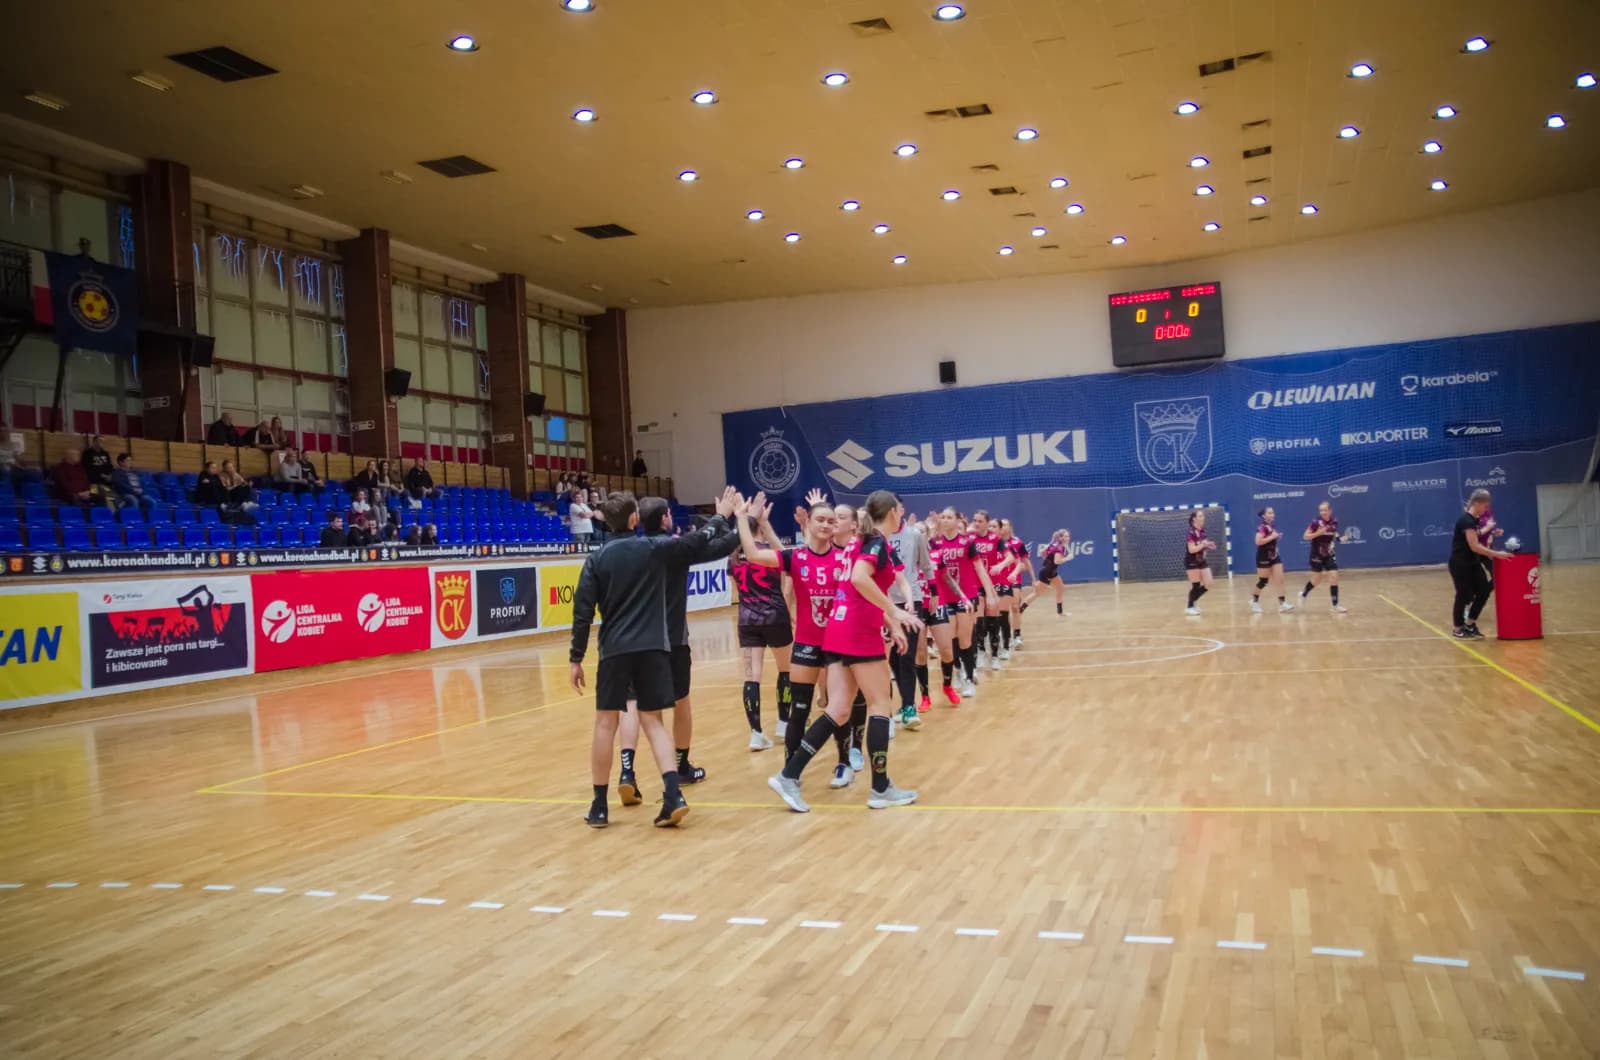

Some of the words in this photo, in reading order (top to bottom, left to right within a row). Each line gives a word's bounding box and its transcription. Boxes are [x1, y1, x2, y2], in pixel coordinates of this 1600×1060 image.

[1136, 308, 1147, 323] 0
[1188, 302, 1199, 317] 0
[1422, 372, 1489, 388] karabela
[1274, 381, 1376, 408] LEWIATAN
[1350, 427, 1429, 446] KOLPORTER
[1268, 438, 1320, 450] PROFIKA
[884, 429, 1088, 477] SUZUKI
[260, 549, 359, 563] www.koronahandball.pl
[943, 547, 957, 560] 20
[1036, 541, 1095, 558] PNiG
[67, 553, 206, 569] www.koronahandball.pl
[816, 566, 827, 585] 5
[385, 597, 401, 606] LIGA
[296, 604, 315, 614] LIGA
[385, 606, 424, 617] CENTRALNA
[439, 598, 466, 632] CK
[490, 605, 527, 619] PROFIKA
[296, 613, 343, 626] CENTRALNA
[386, 617, 410, 627] KOBIET
[297, 625, 326, 637] KOBIET
[105, 649, 144, 659] Zawsze
[145, 645, 163, 656] jest
[164, 644, 184, 654] pora
[186, 642, 197, 650] na
[112, 658, 168, 672] kibicowanie
